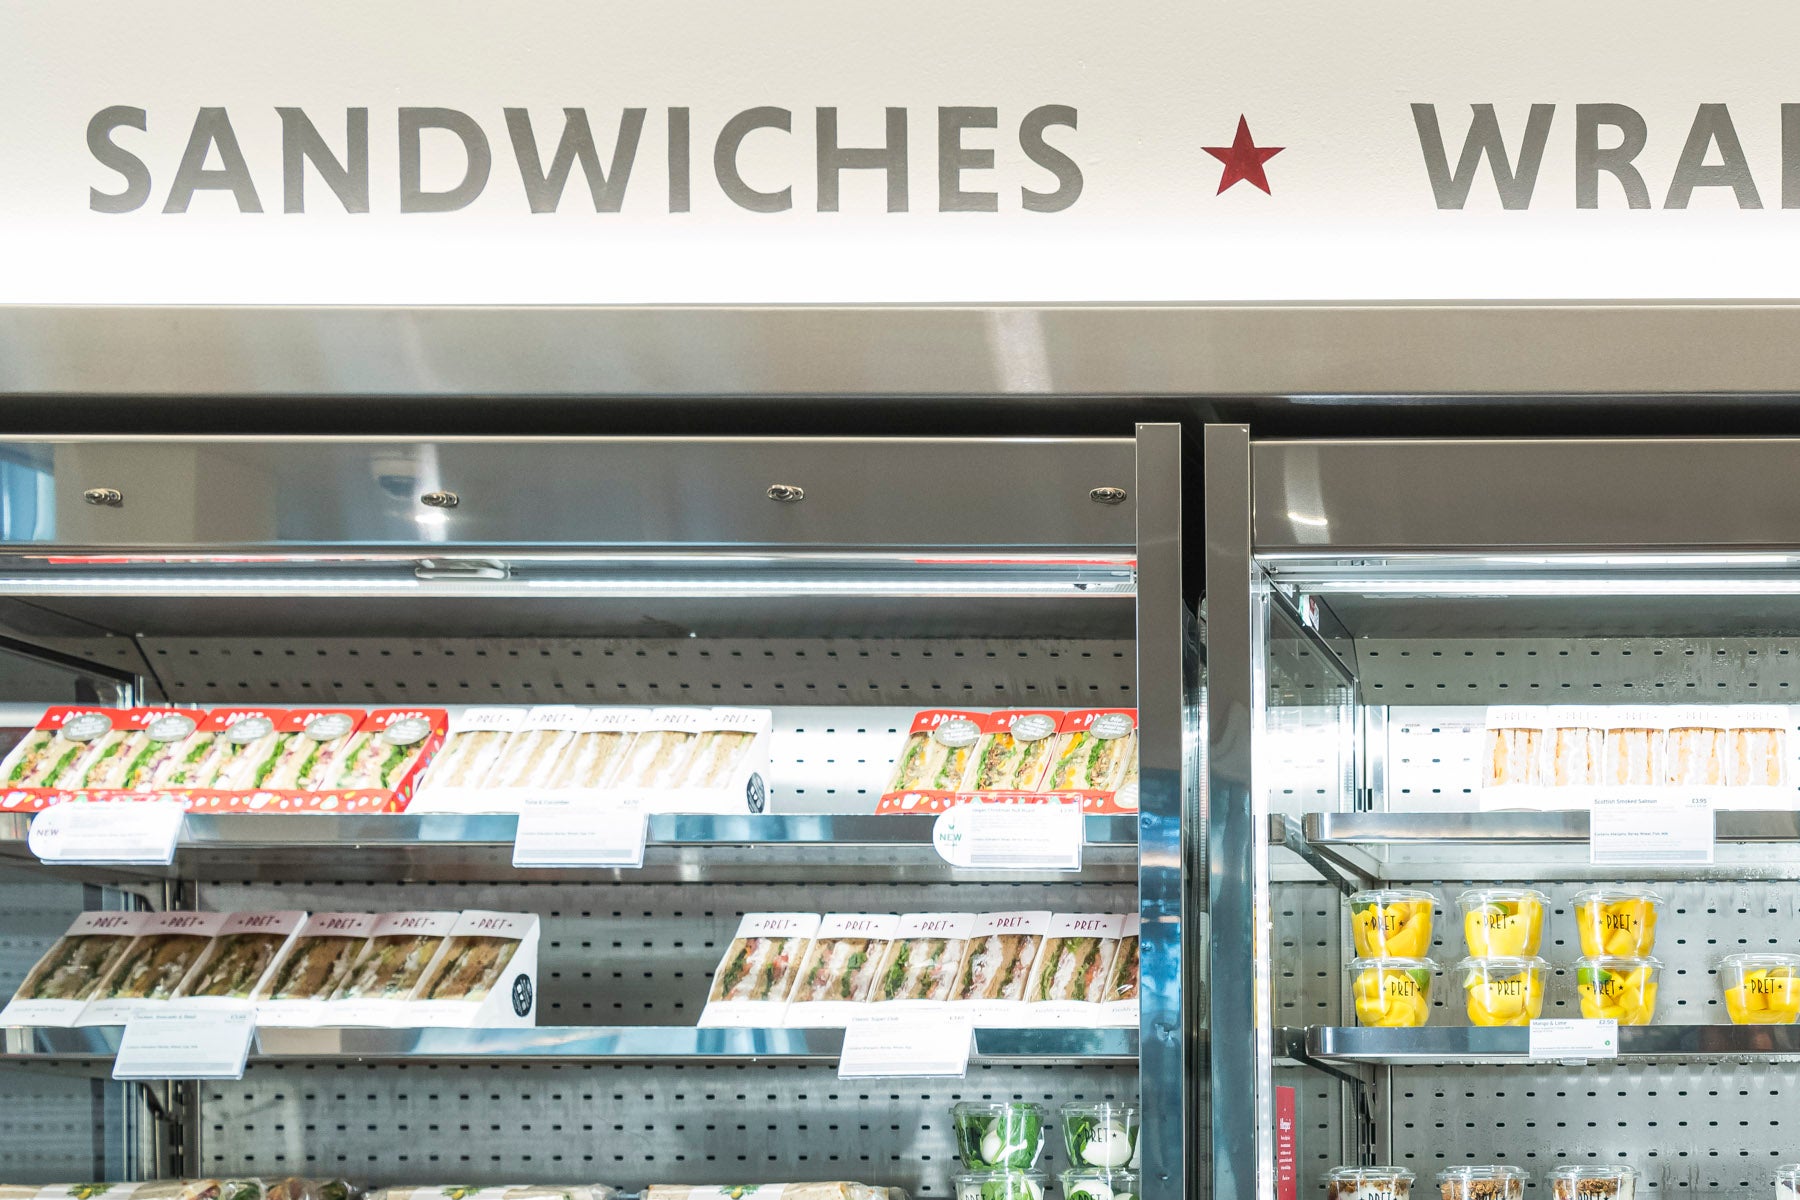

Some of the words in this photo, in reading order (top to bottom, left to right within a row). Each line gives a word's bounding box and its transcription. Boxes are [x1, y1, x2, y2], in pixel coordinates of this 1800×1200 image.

[86, 104, 1085, 214] SANDWICHES
[36, 828, 60, 836] NEW
[939, 833, 962, 841] NEW
[168, 917, 198, 929] PRET
[763, 920, 789, 931] PRET
[1497, 980, 1521, 995] PRET
[1750, 978, 1774, 994] PRET
[1085, 1128, 1109, 1143] PRET
